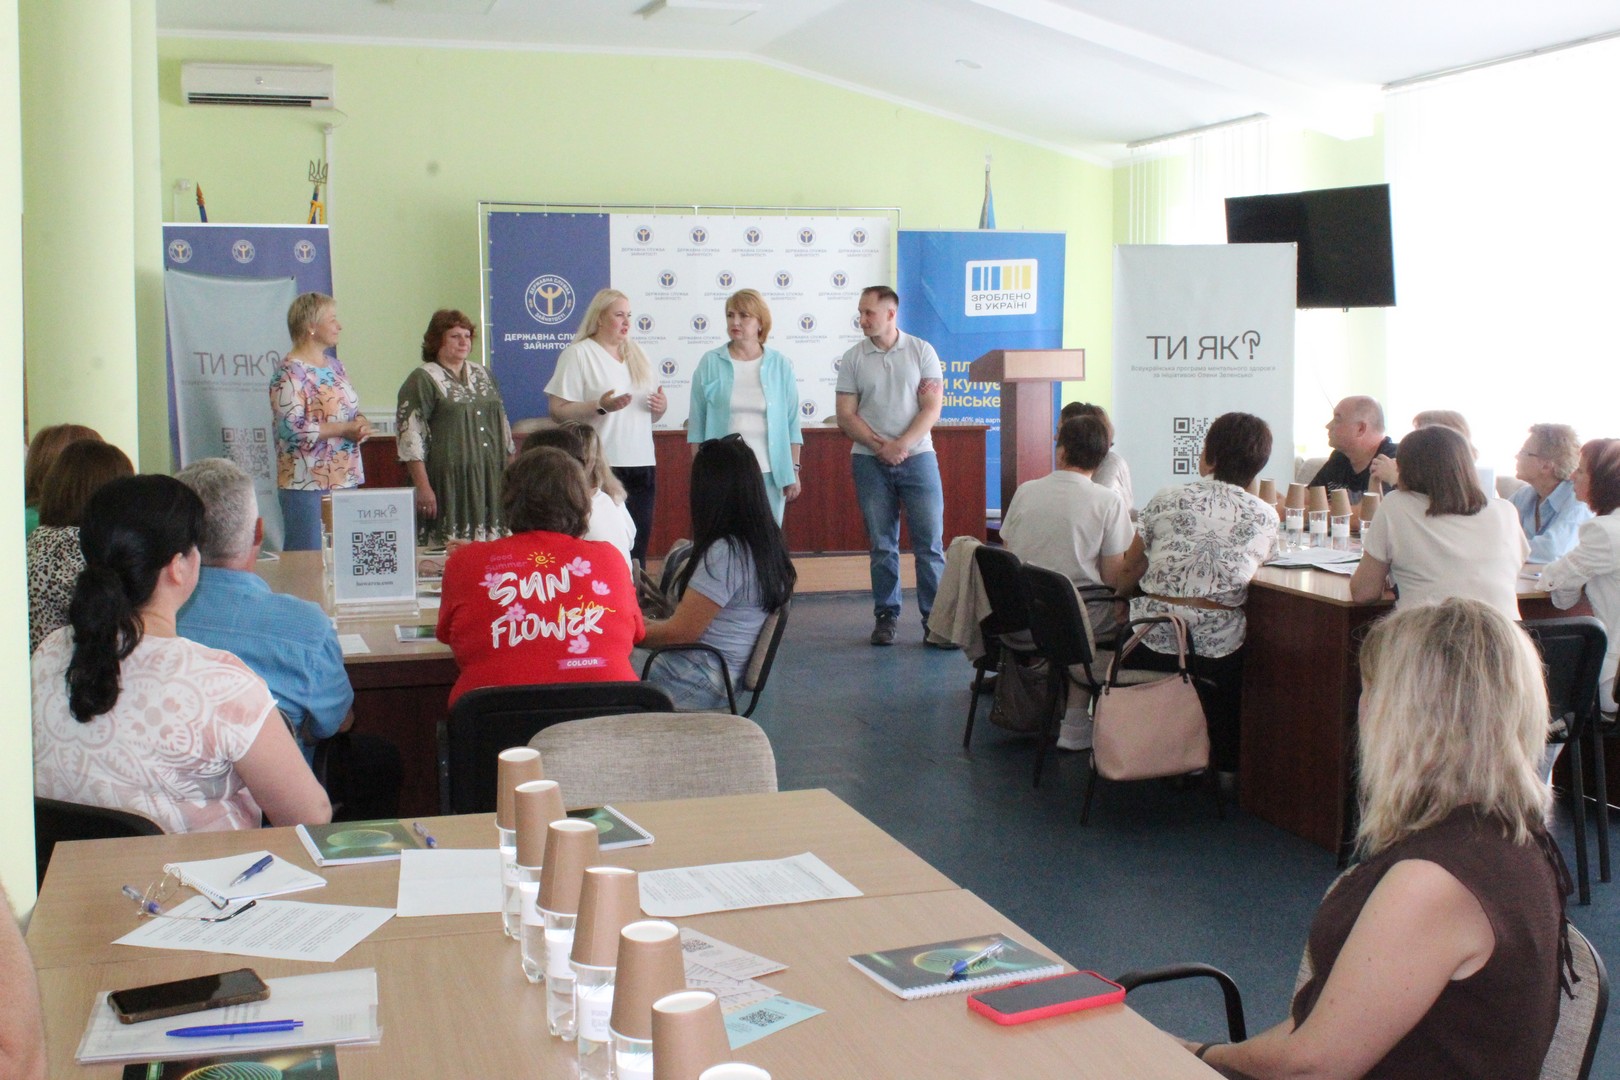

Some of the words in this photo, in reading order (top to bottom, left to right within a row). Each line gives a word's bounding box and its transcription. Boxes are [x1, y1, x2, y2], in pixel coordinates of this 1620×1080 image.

[971, 292, 1031, 301] ЗРОБЛЕНО
[986, 300, 1027, 310] УКРАЇНІ
[505, 333, 556, 341] ДЕРЖАВНА
[1146, 336, 1187, 360] ТИ
[193, 352, 226, 375] ТИ
[357, 510, 371, 518] ТИ
[485, 562, 528, 572] Summer
[489, 566, 570, 606] SUN
[490, 605, 604, 649] FLOWER
[567, 659, 598, 667] COLOUR
